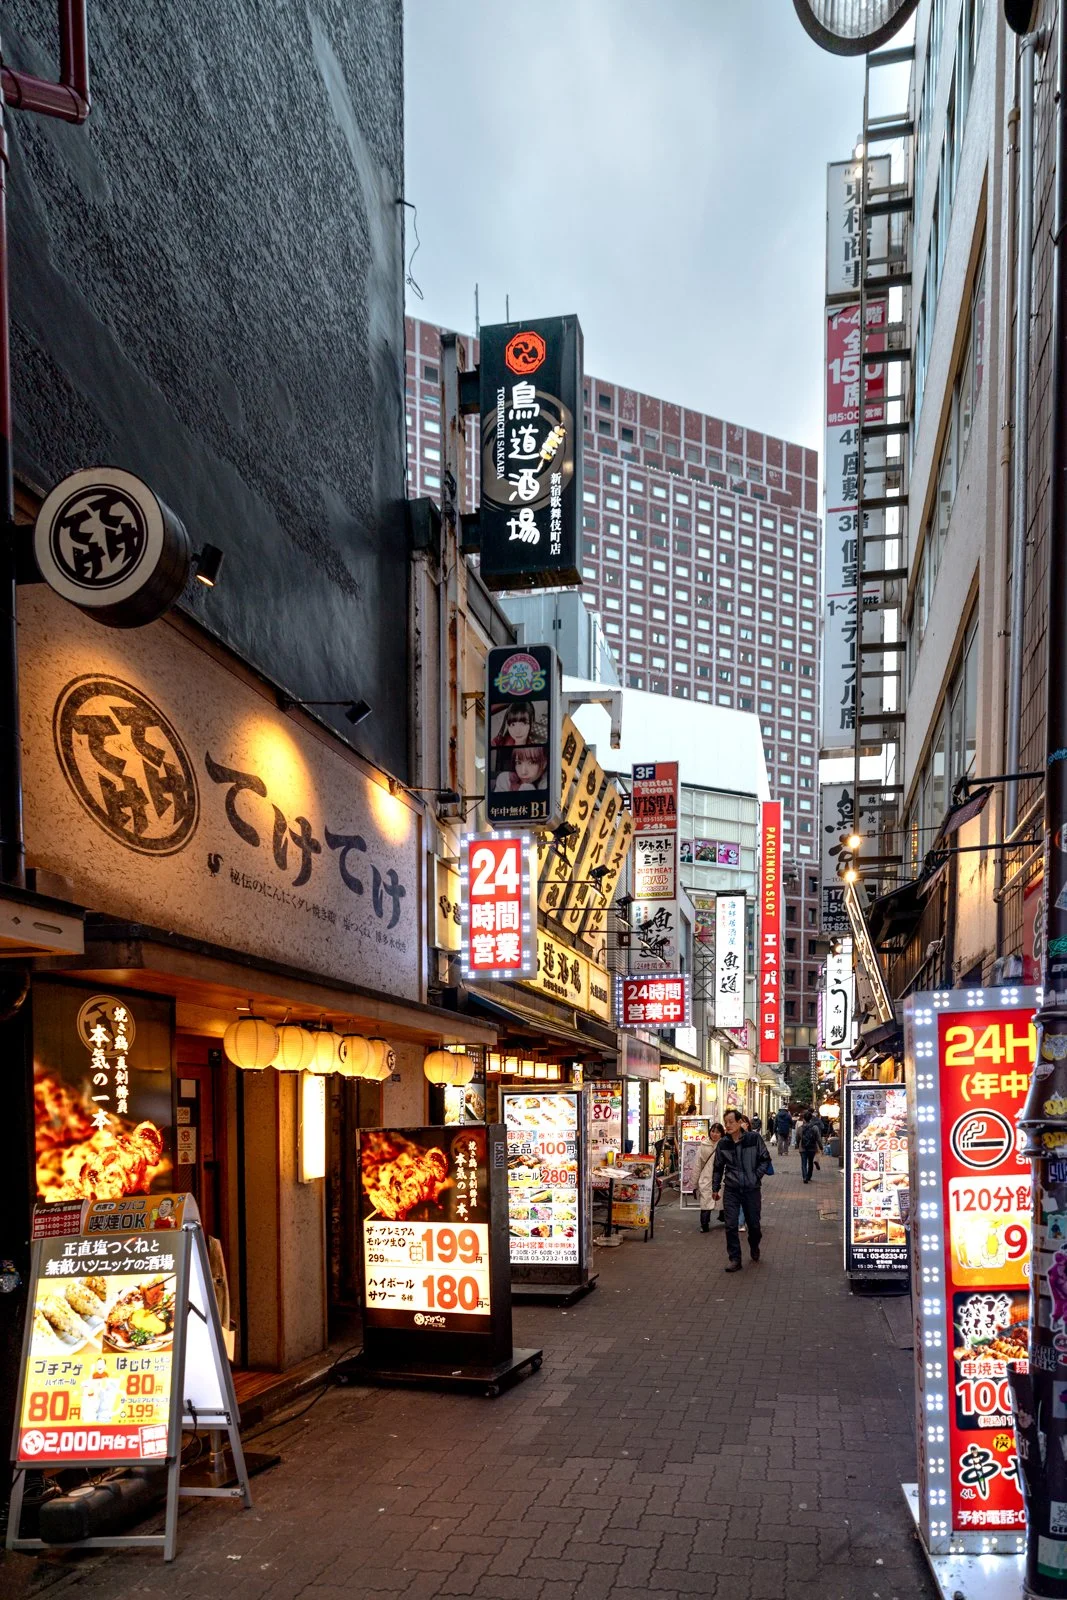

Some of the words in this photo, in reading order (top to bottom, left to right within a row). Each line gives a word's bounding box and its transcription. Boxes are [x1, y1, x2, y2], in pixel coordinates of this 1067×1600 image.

[496, 387, 505, 438] TORIMICHI
[496, 439, 505, 480] SAKABA
[549, 472, 562, 555] 新宿歌舞伎町店
[635, 766, 654, 779] 3F
[634, 779, 673, 788] Rental
[641, 787, 674, 795] Room
[490, 805, 528, 817] 年中無休
[530, 801, 548, 818] B1
[633, 795, 676, 816] VISTA
[203, 749, 407, 930] てけてけ
[638, 839, 672, 850] ジャスト
[644, 853, 666, 864] ミート
[471, 847, 520, 897] 24
[472, 901, 520, 931] 時間
[473, 932, 520, 964] 営業
[537, 939, 582, 994] 道酒場
[719, 951, 740, 994] 魚道
[627, 982, 682, 1000] 24時間
[763, 933, 778, 1040] エスパス日拓
[627, 1002, 681, 1020] 営業中
[509, 1143, 532, 1154] 全品
[511, 1172, 540, 1182] 生ビール
[541, 1170, 576, 1184] 280円
[118, 1200, 146, 1211] タバコ
[89, 1212, 148, 1232] 喫煙OK
[366, 1227, 415, 1236] ザ・プレミアム
[62, 1237, 160, 1257] 正直塩つくねと
[45, 1254, 176, 1275] 無敵ハツユッケの酒場
[368, 1277, 415, 1290] ハイボール
[368, 1290, 396, 1301] サワー
[969, 1296, 983, 1337] やきとり
[984, 1296, 996, 1335] うまい
[116, 1357, 151, 1372] はじけ
[963, 1361, 1029, 1376] 串焼き場
[45, 1379, 76, 1387] ハイボール
[28, 1391, 81, 1422] 80円
[44, 1431, 140, 1454] 2,000円台で
[962, 1489, 976, 1498] くし
